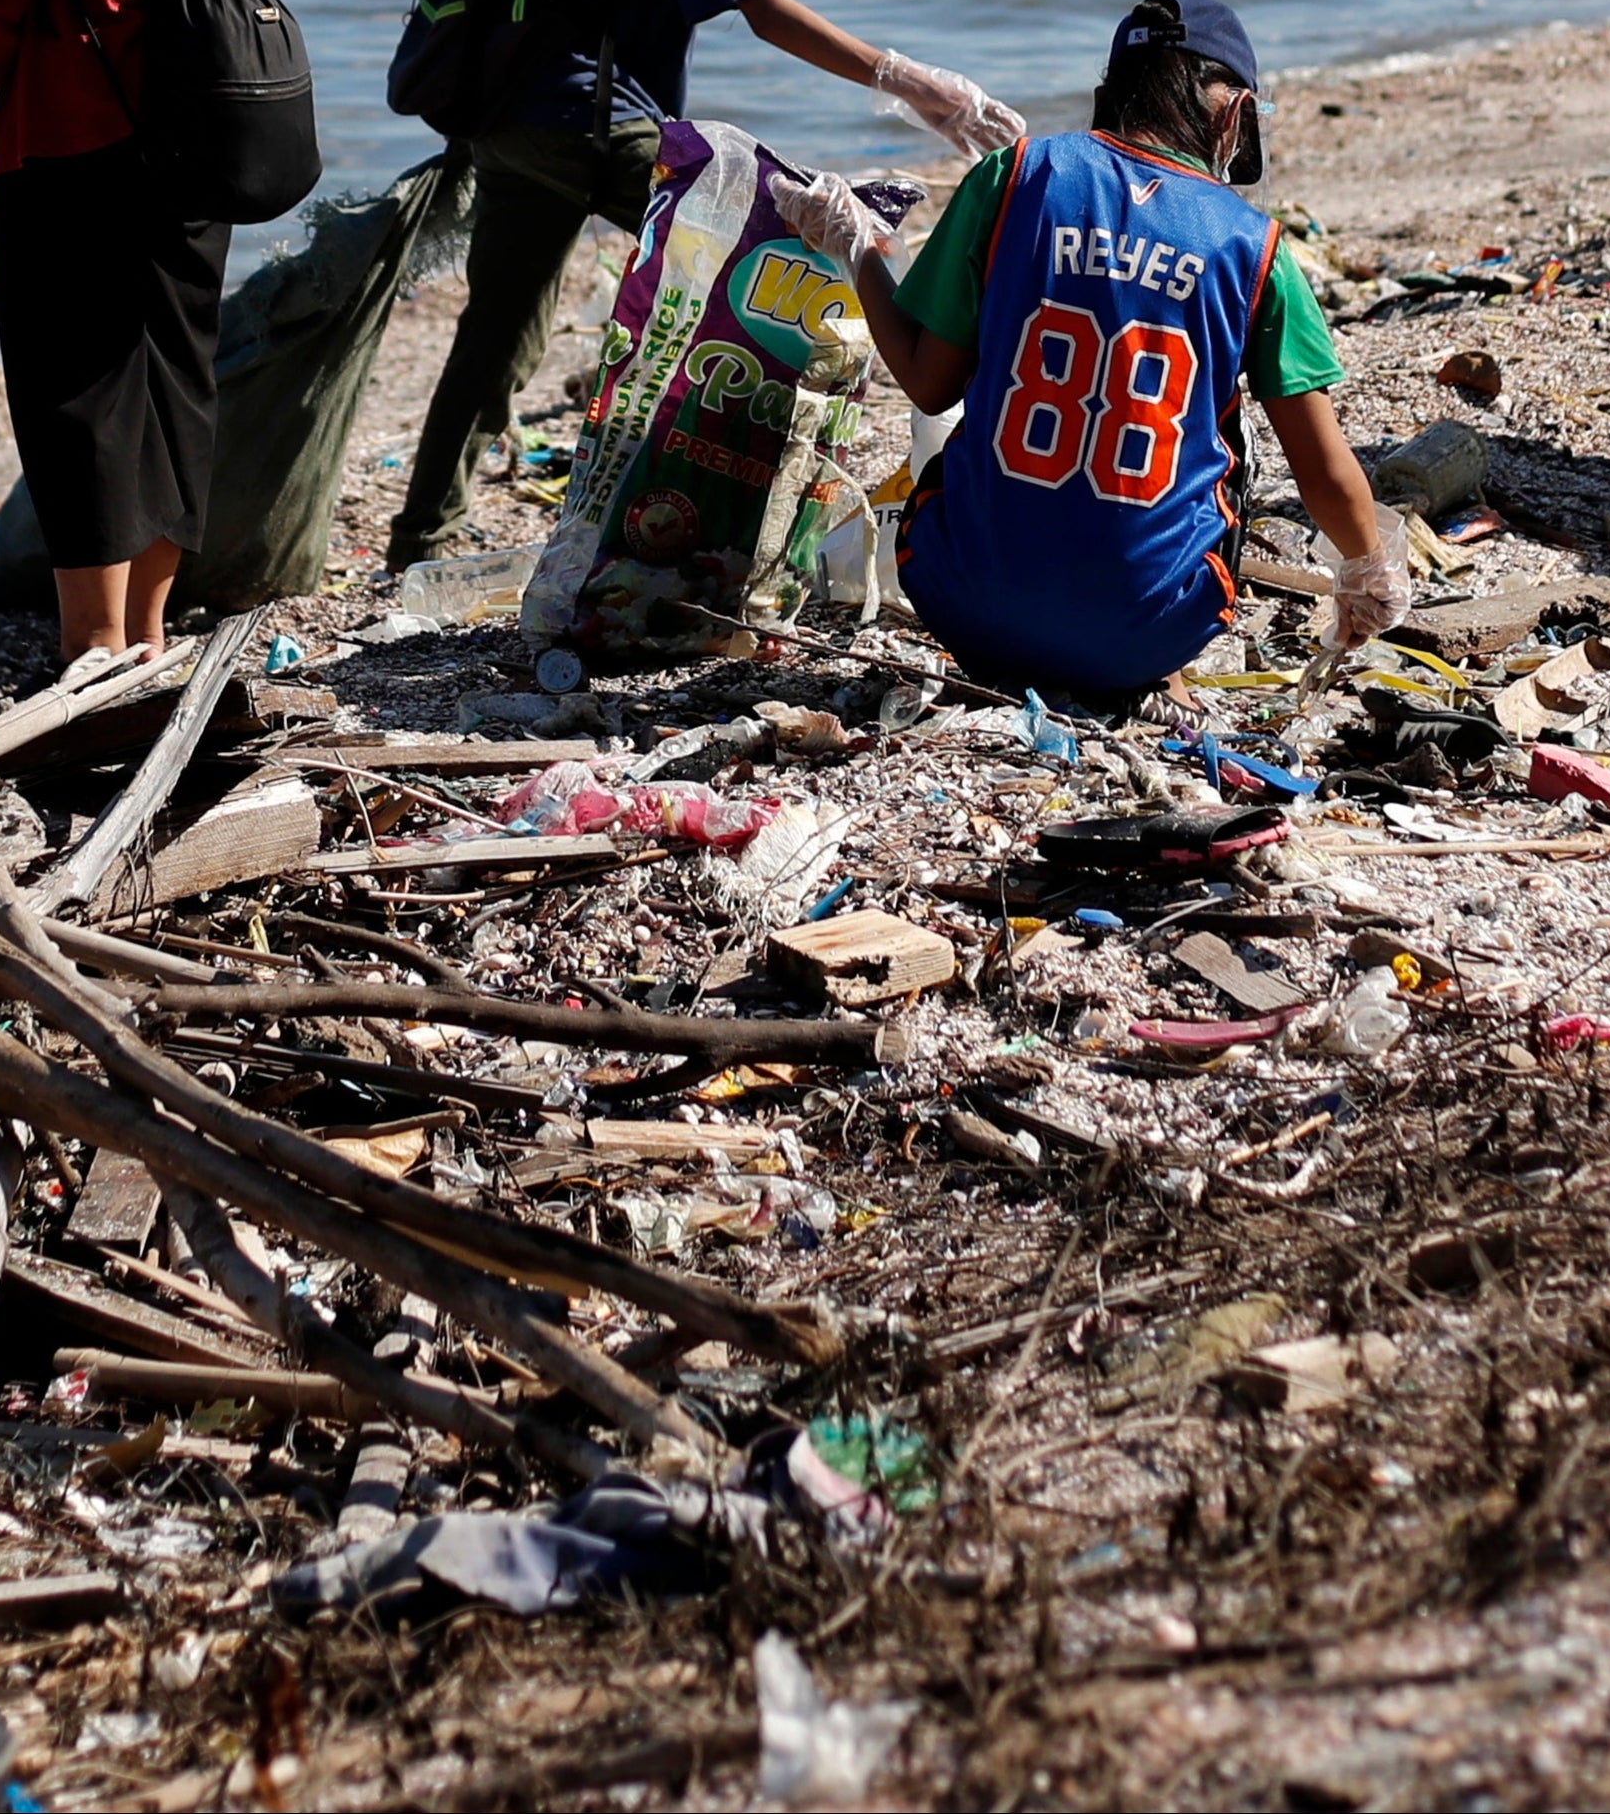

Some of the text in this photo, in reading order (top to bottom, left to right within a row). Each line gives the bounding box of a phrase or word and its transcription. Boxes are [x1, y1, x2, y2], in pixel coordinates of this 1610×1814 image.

[1054, 226, 1205, 301] REYES
[642, 285, 683, 362] RICE
[628, 298, 702, 443] PREMIUM
[992, 297, 1199, 508] 88
[663, 429, 779, 487] PREMI
